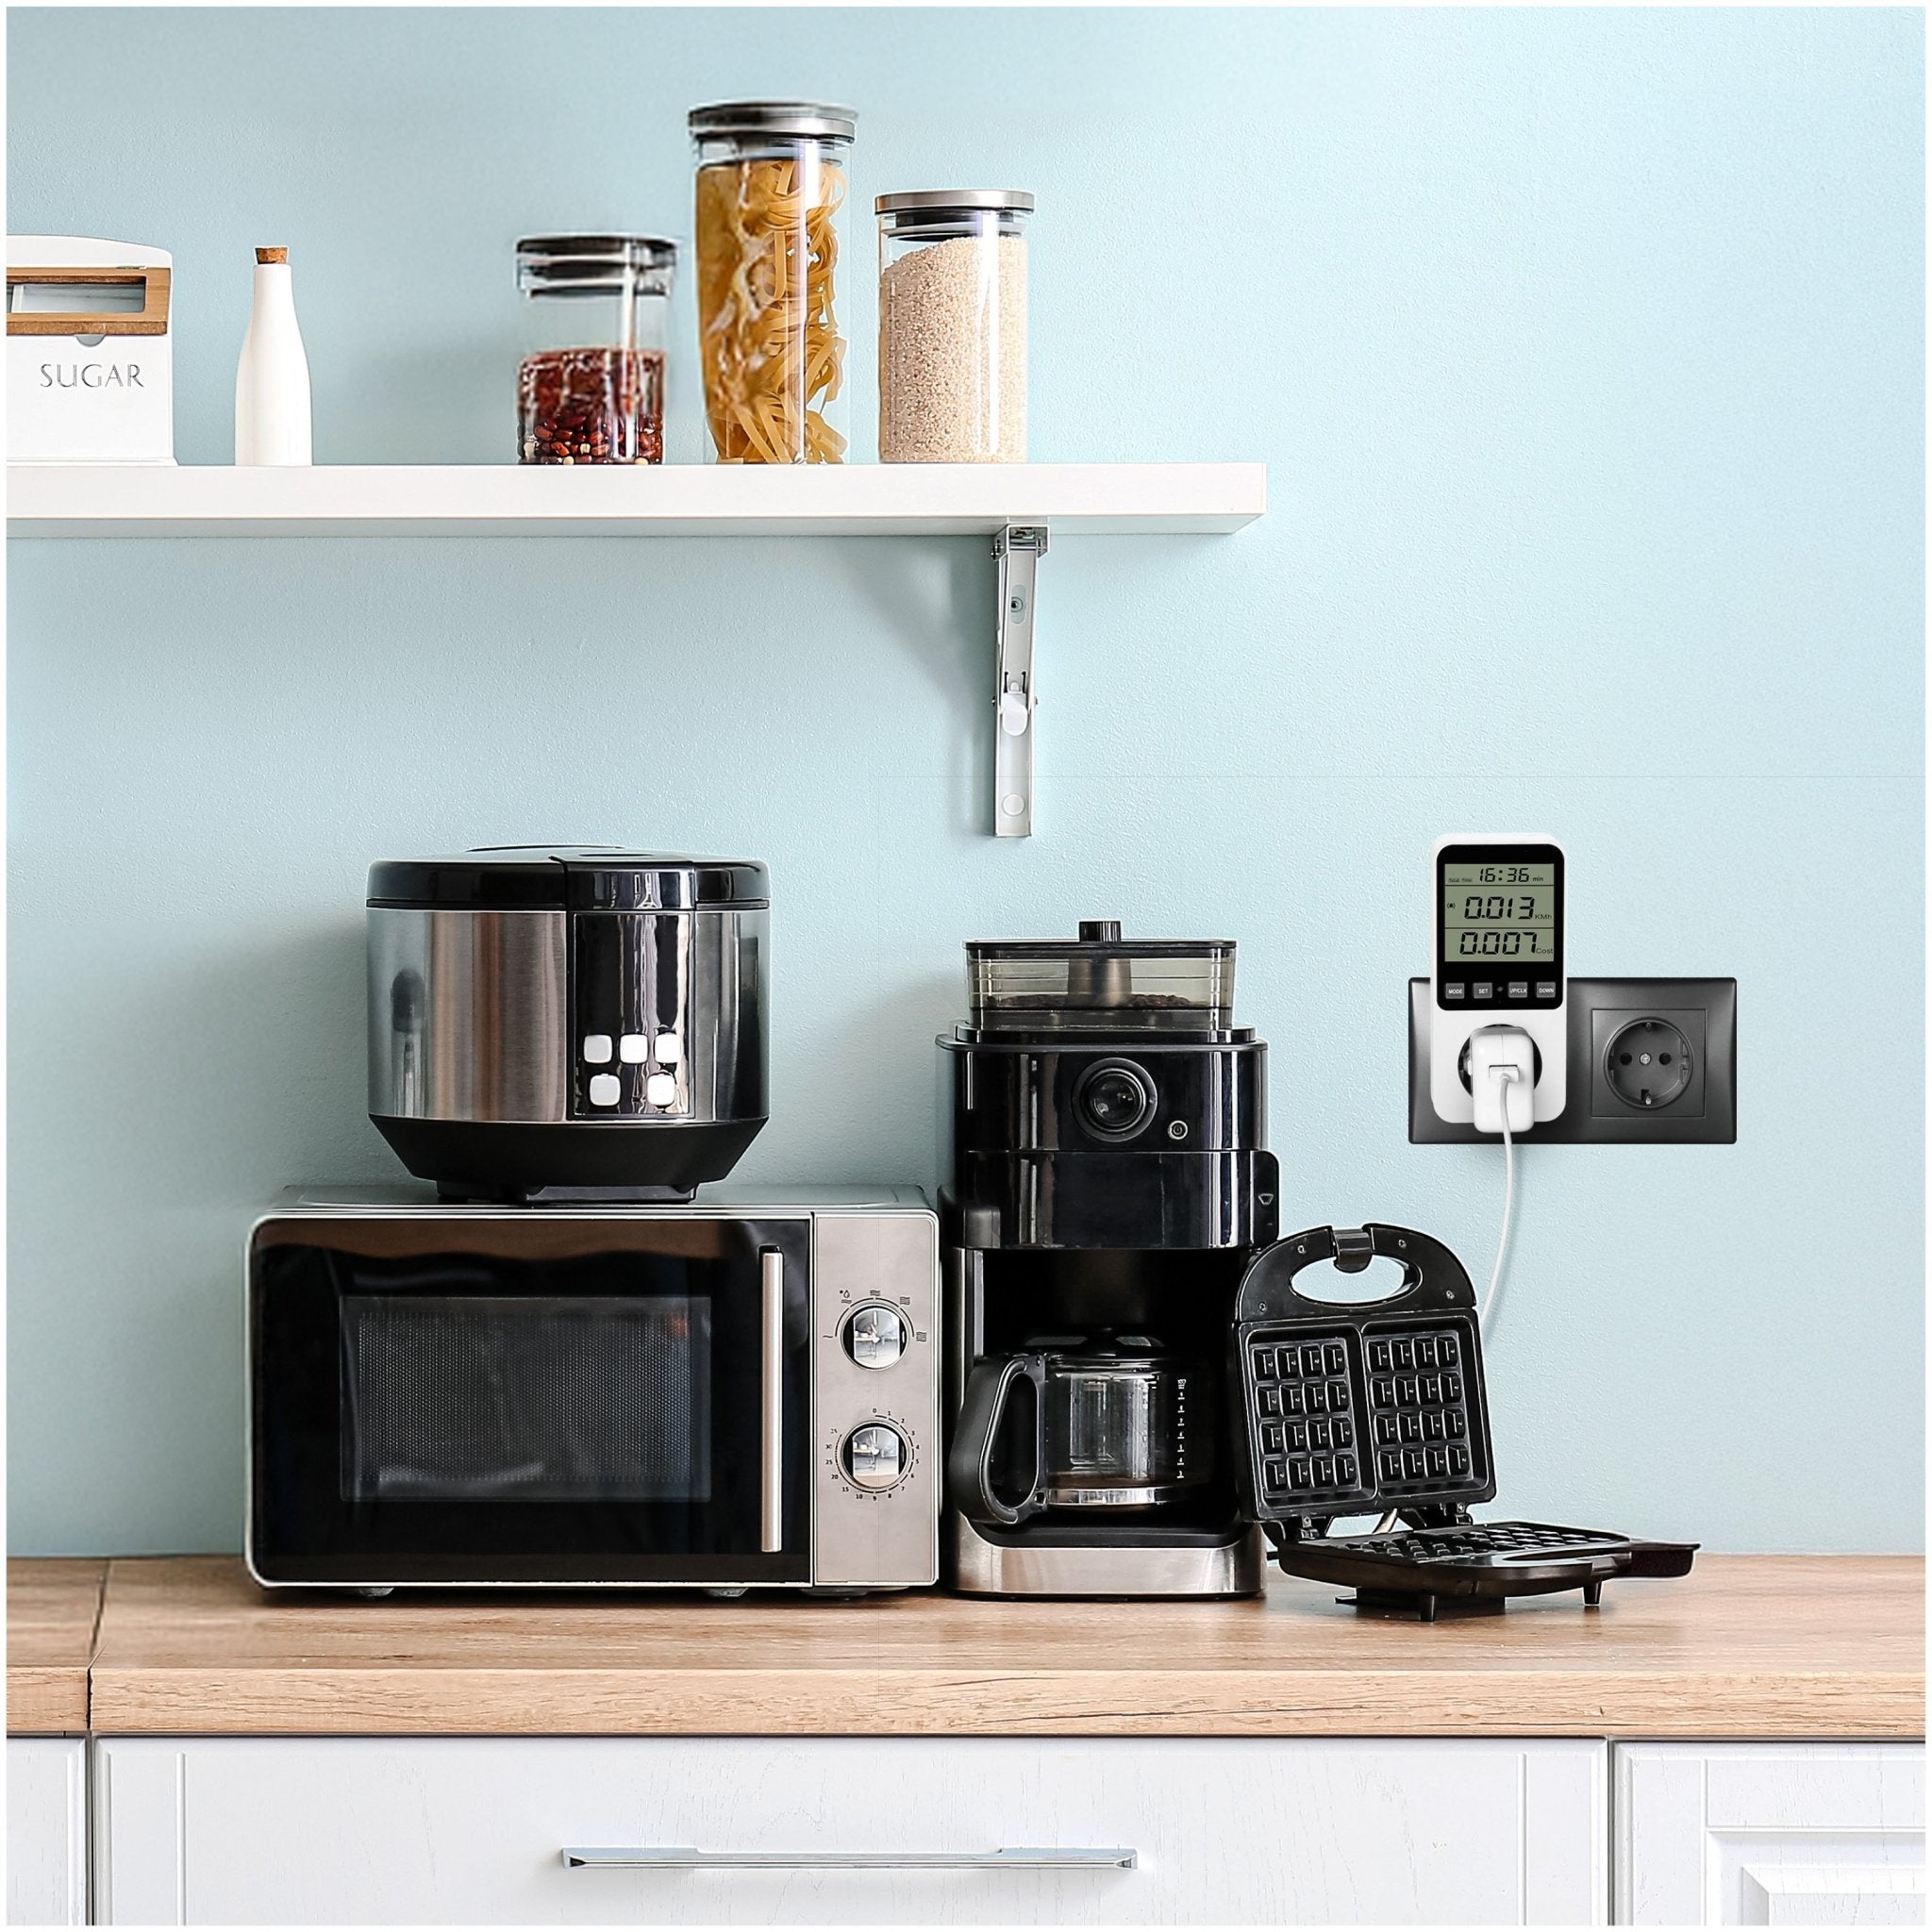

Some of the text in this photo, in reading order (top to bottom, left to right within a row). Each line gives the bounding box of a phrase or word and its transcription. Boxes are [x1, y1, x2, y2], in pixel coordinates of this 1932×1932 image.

[40, 363, 144, 388] SUGAR
[1479, 867, 1530, 883] 16:36
[1464, 896, 1535, 920] 0.013
[1459, 931, 1538, 956] 0.007
